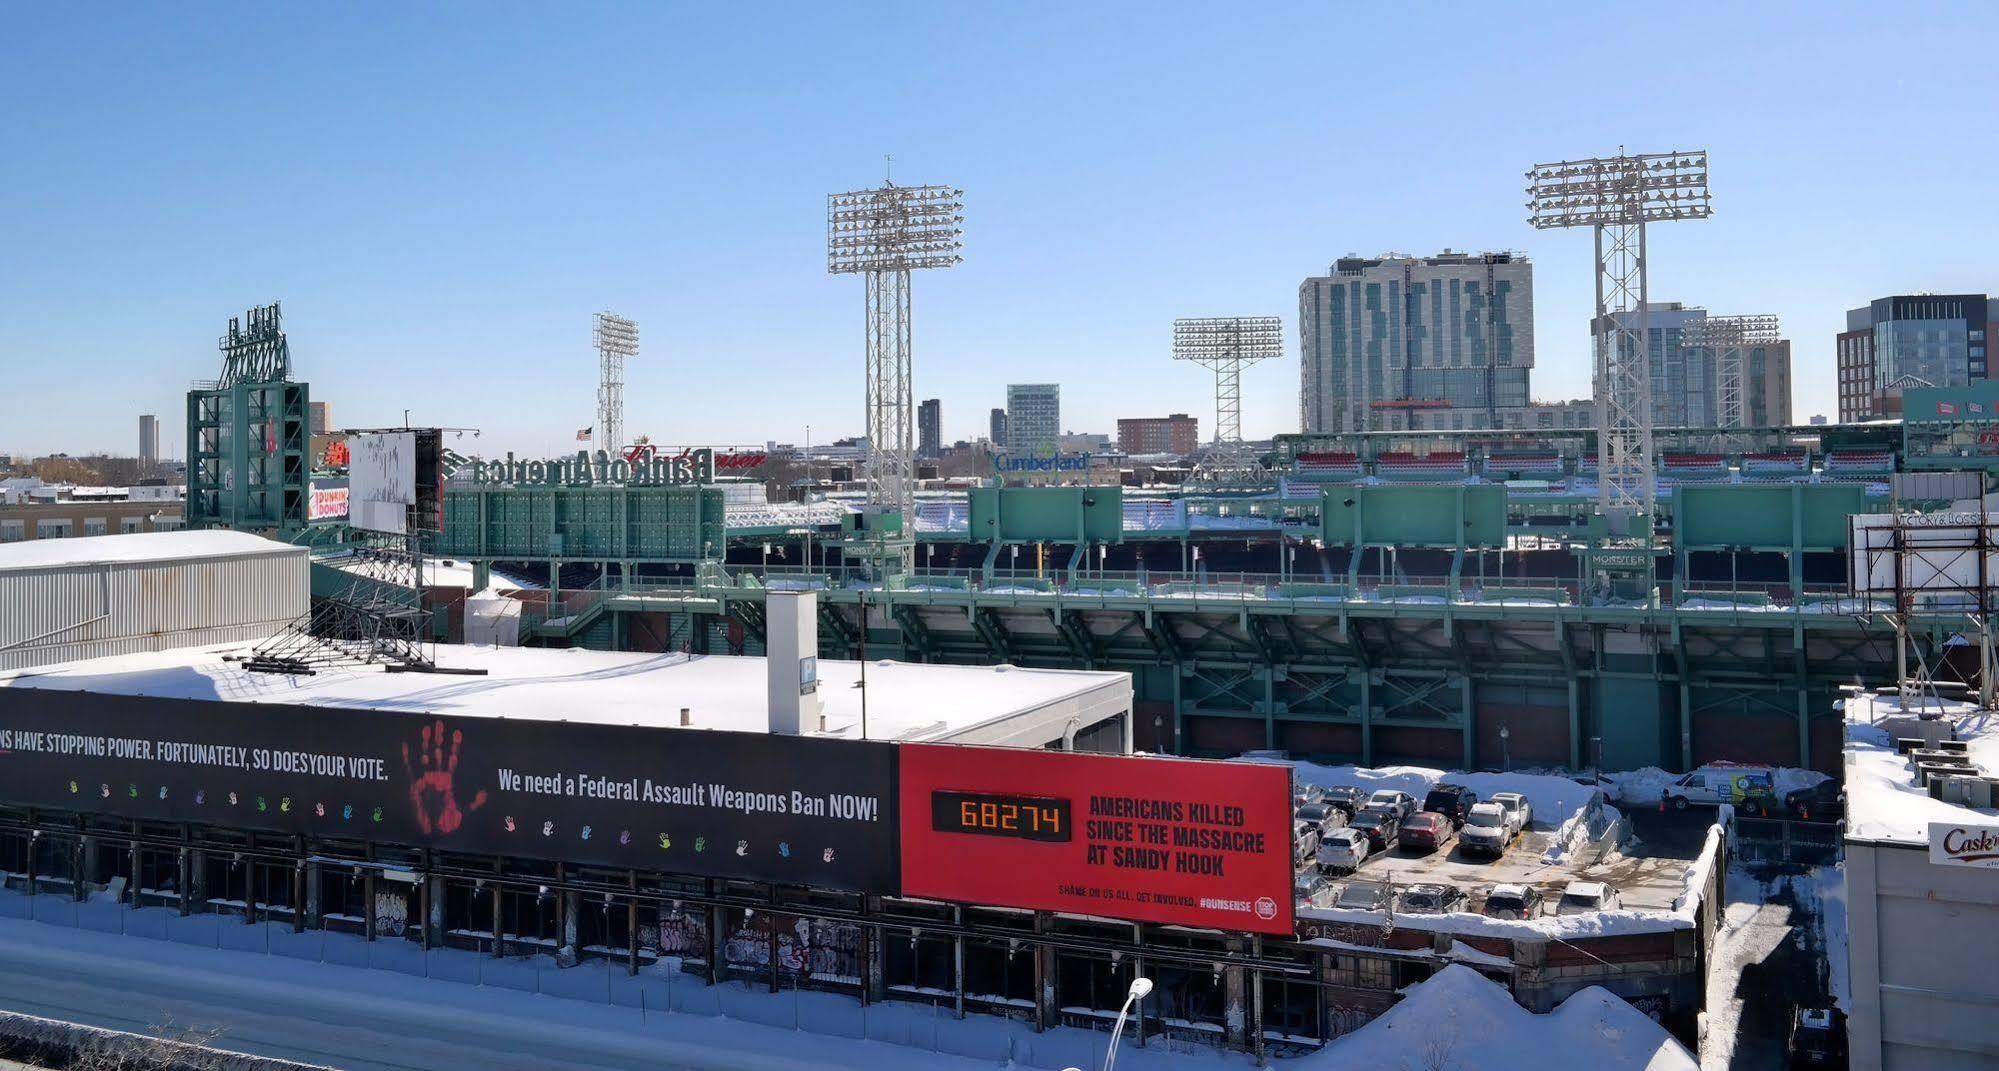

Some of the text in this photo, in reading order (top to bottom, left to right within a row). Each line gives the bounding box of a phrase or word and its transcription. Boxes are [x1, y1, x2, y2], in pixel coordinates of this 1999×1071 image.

[995, 453, 1087, 471] Cumberland
[319, 503, 347, 515] DONUTS
[1593, 554, 1645, 565] MONSTER
[14, 730, 44, 751] HAVE
[46, 733, 105, 757] STOPPING
[107, 737, 155, 761] POWER.
[157, 741, 249, 771] FORTUNATELY,
[253, 748, 270, 770] SO
[349, 757, 388, 781] VOTE.
[498, 768, 878, 822] We need a Federal Assault Weapons Ban NOW!
[1089, 795, 1244, 827] AMERICANS KILLED
[961, 801, 1060, 833] 68274
[1087, 820, 1265, 854] SINCE THE MASSACRE
[1087, 844, 1225, 877] AT SANDY HOOK
[1103, 889, 1114, 899] US
[1136, 891, 1151, 903] GET
[1200, 898, 1252, 912] #GUNSENSE
